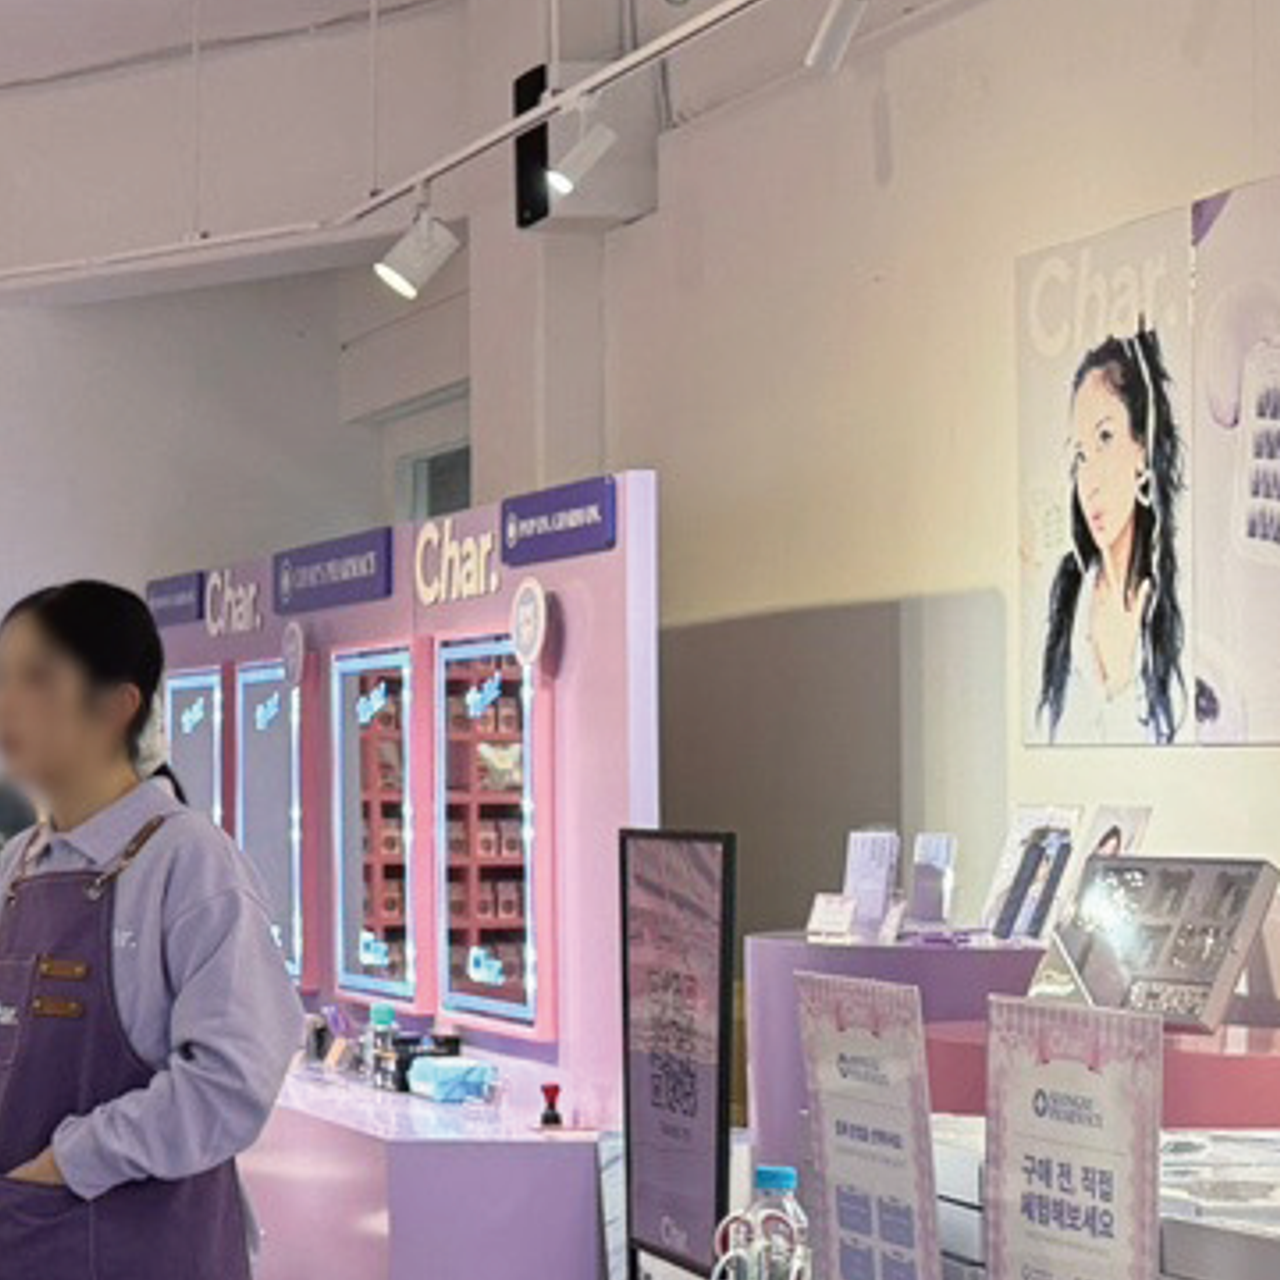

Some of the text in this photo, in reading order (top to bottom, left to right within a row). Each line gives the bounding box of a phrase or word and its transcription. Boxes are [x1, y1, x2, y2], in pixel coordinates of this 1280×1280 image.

[415, 519, 499, 605] Char.
[1021, 1153, 1053, 1188] 구매
[1081, 1166, 1114, 1203] 직접
